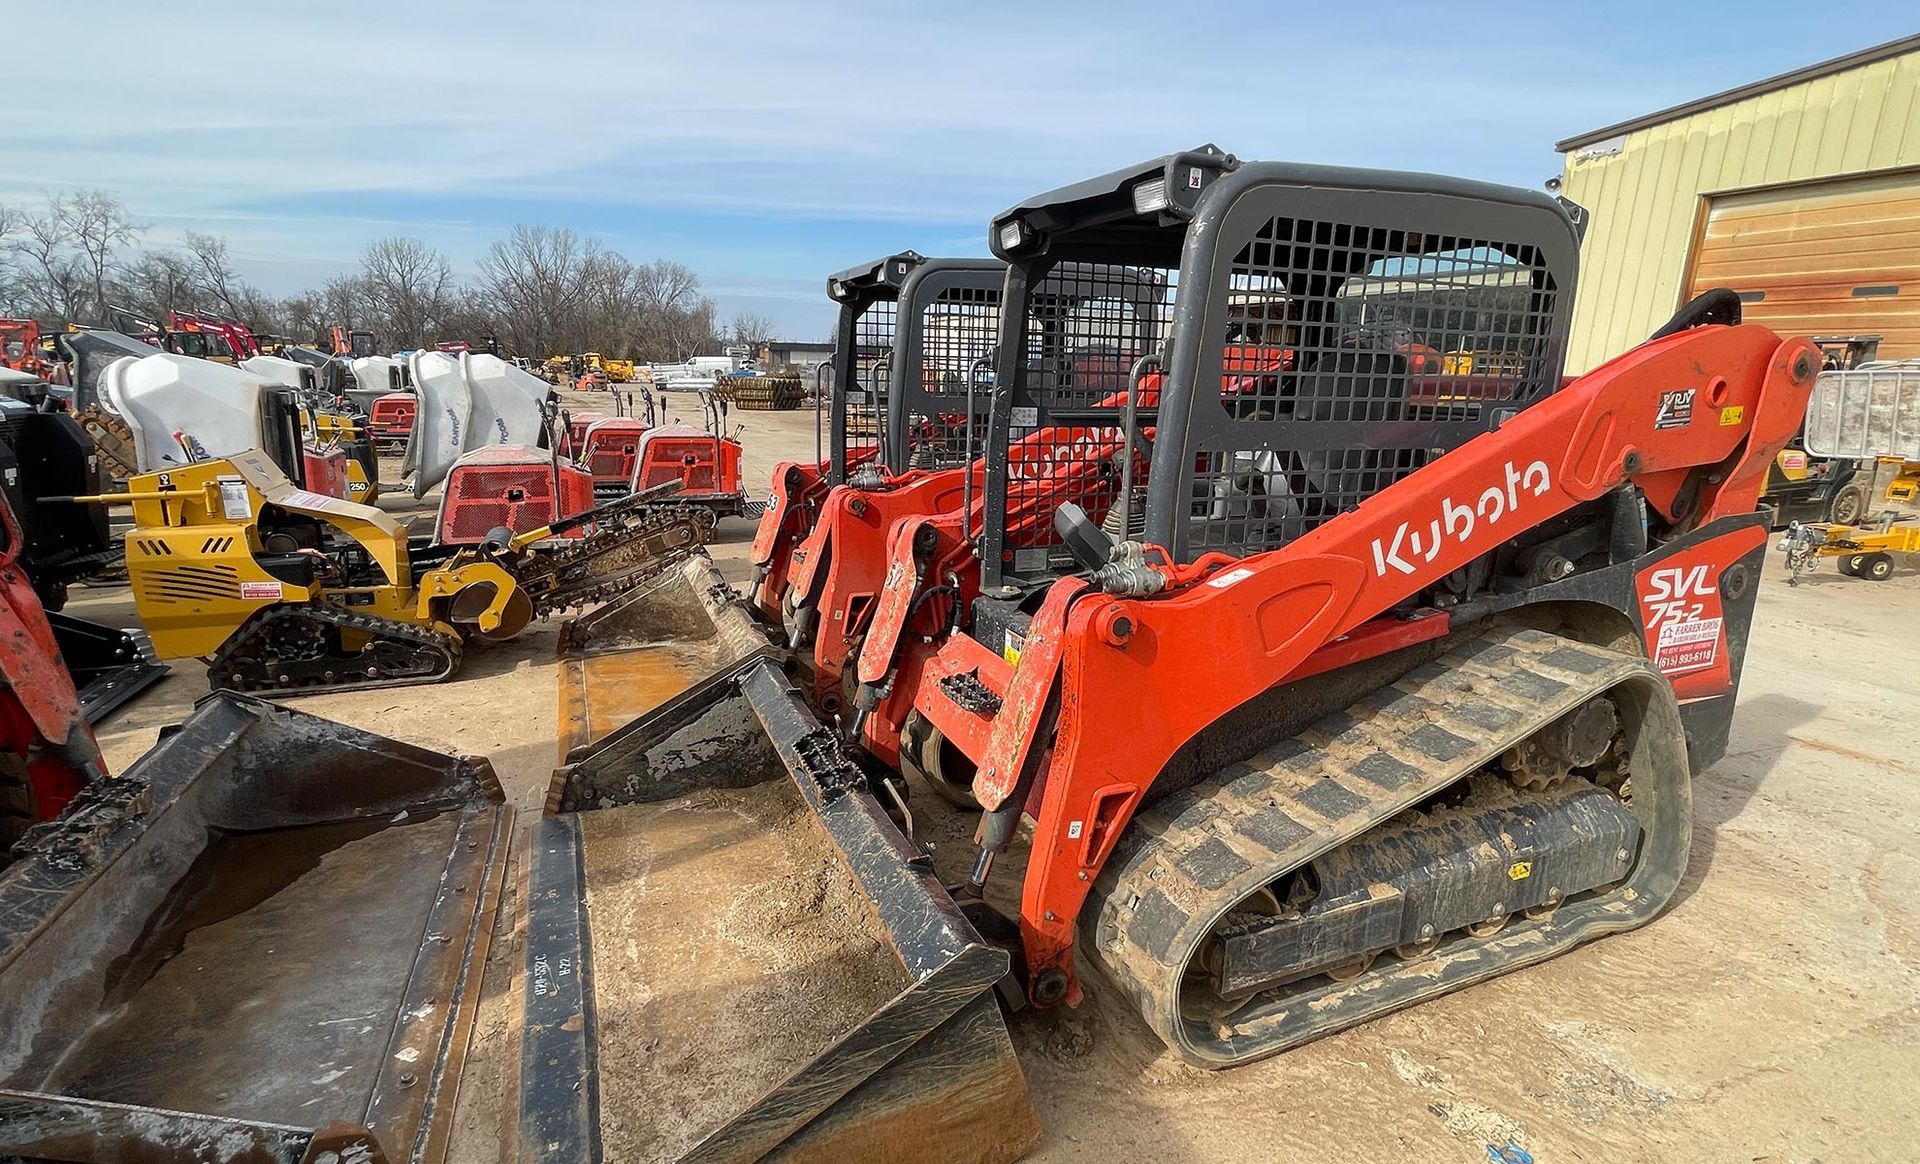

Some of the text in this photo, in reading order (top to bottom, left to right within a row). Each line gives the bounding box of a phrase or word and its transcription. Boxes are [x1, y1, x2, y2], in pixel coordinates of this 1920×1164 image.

[446, 407, 460, 446] CANYCOM
[350, 483, 366, 491] 250
[1371, 460, 1551, 577] Kubota
[1643, 565, 1716, 602] SVL
[1646, 600, 1704, 629] 75-2
[1674, 623, 1702, 635] FARRER
